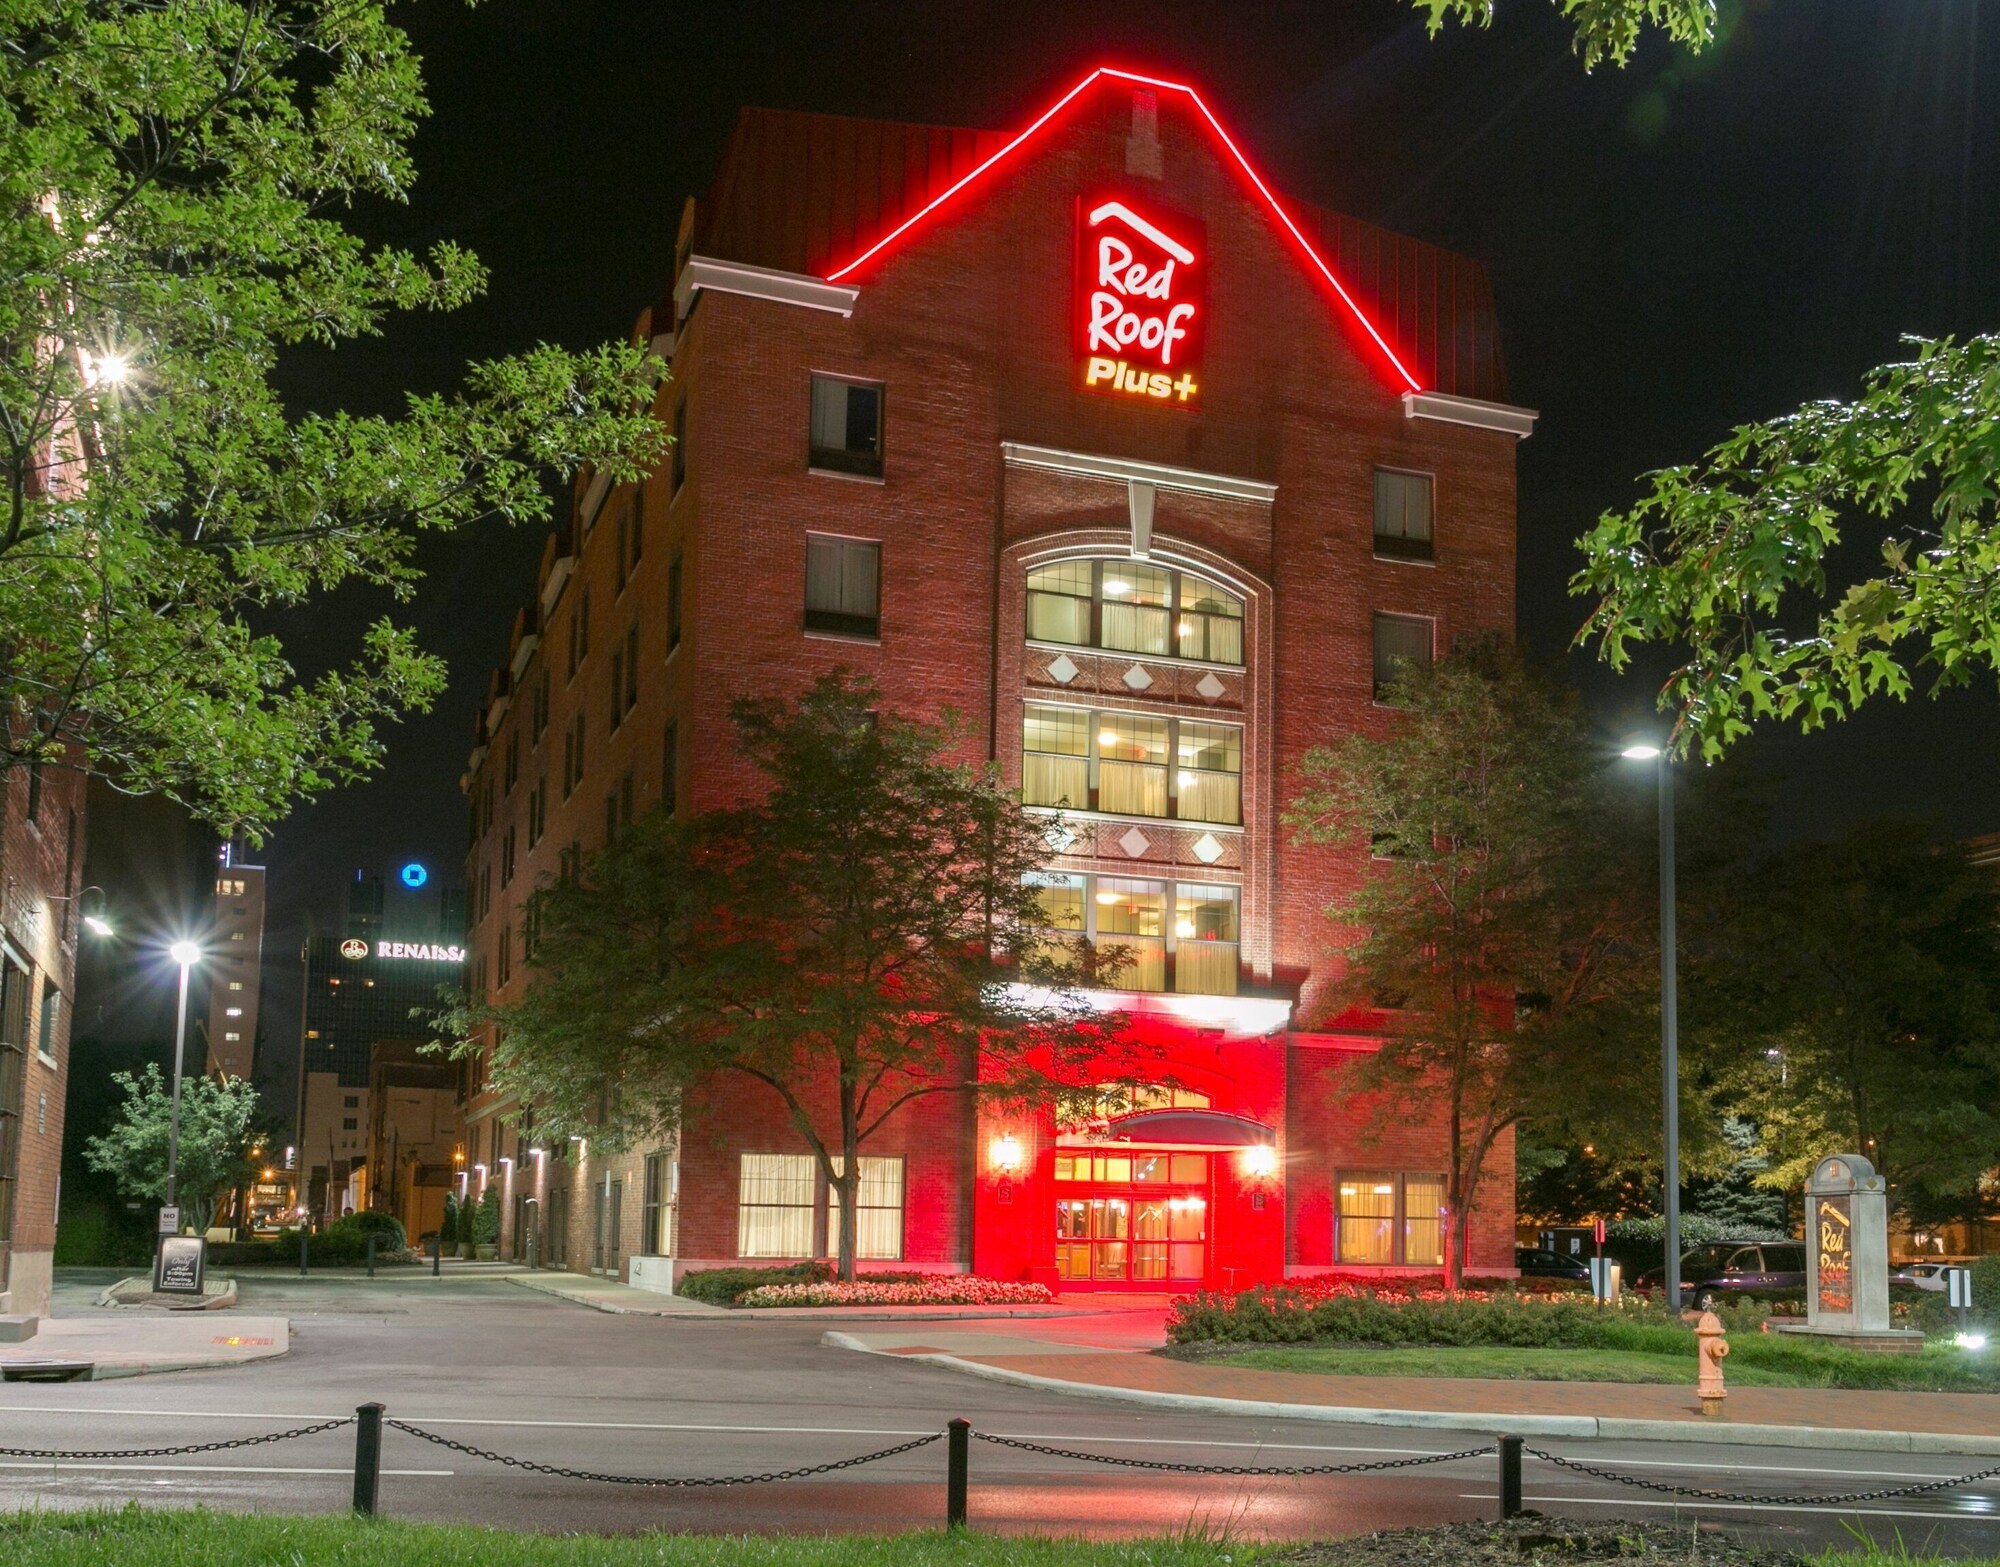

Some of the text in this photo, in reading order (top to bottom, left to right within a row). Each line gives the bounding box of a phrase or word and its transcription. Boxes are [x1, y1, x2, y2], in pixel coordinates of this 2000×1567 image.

[1099, 236, 1175, 300] Red
[1088, 291, 1195, 365] Roof
[1086, 356, 1197, 401] Plus+
[1821, 1222, 1844, 1252] Red
[1820, 1251, 1851, 1287] Roof
